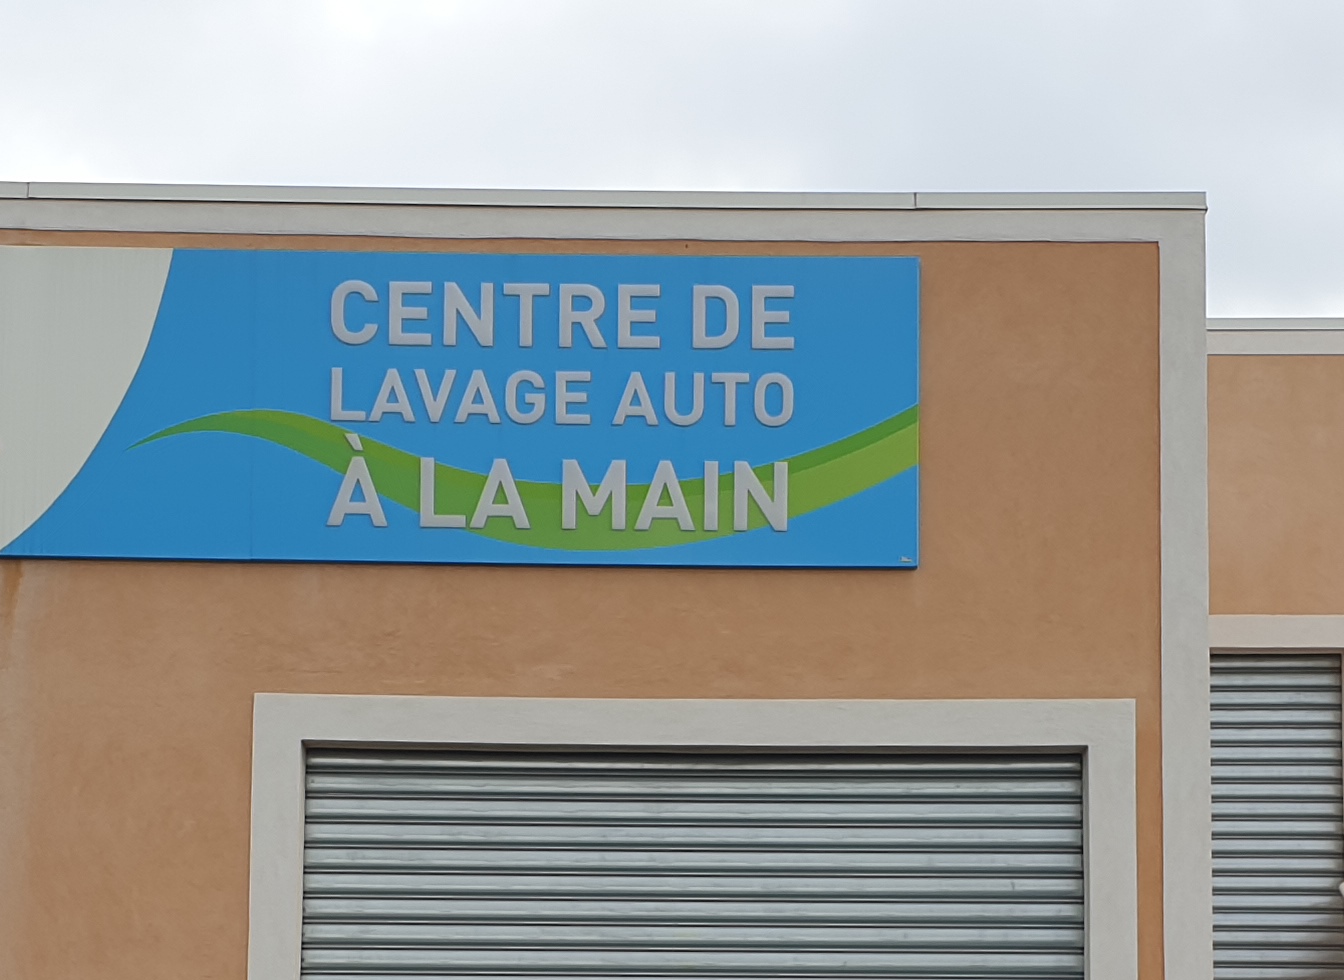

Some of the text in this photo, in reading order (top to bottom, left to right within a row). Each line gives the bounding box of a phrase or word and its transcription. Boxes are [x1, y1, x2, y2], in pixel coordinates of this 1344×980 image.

[329, 279, 797, 351] CENTRE DE
[329, 366, 795, 428] LAVAGE AUTO
[326, 433, 791, 533] À LA MAIN
